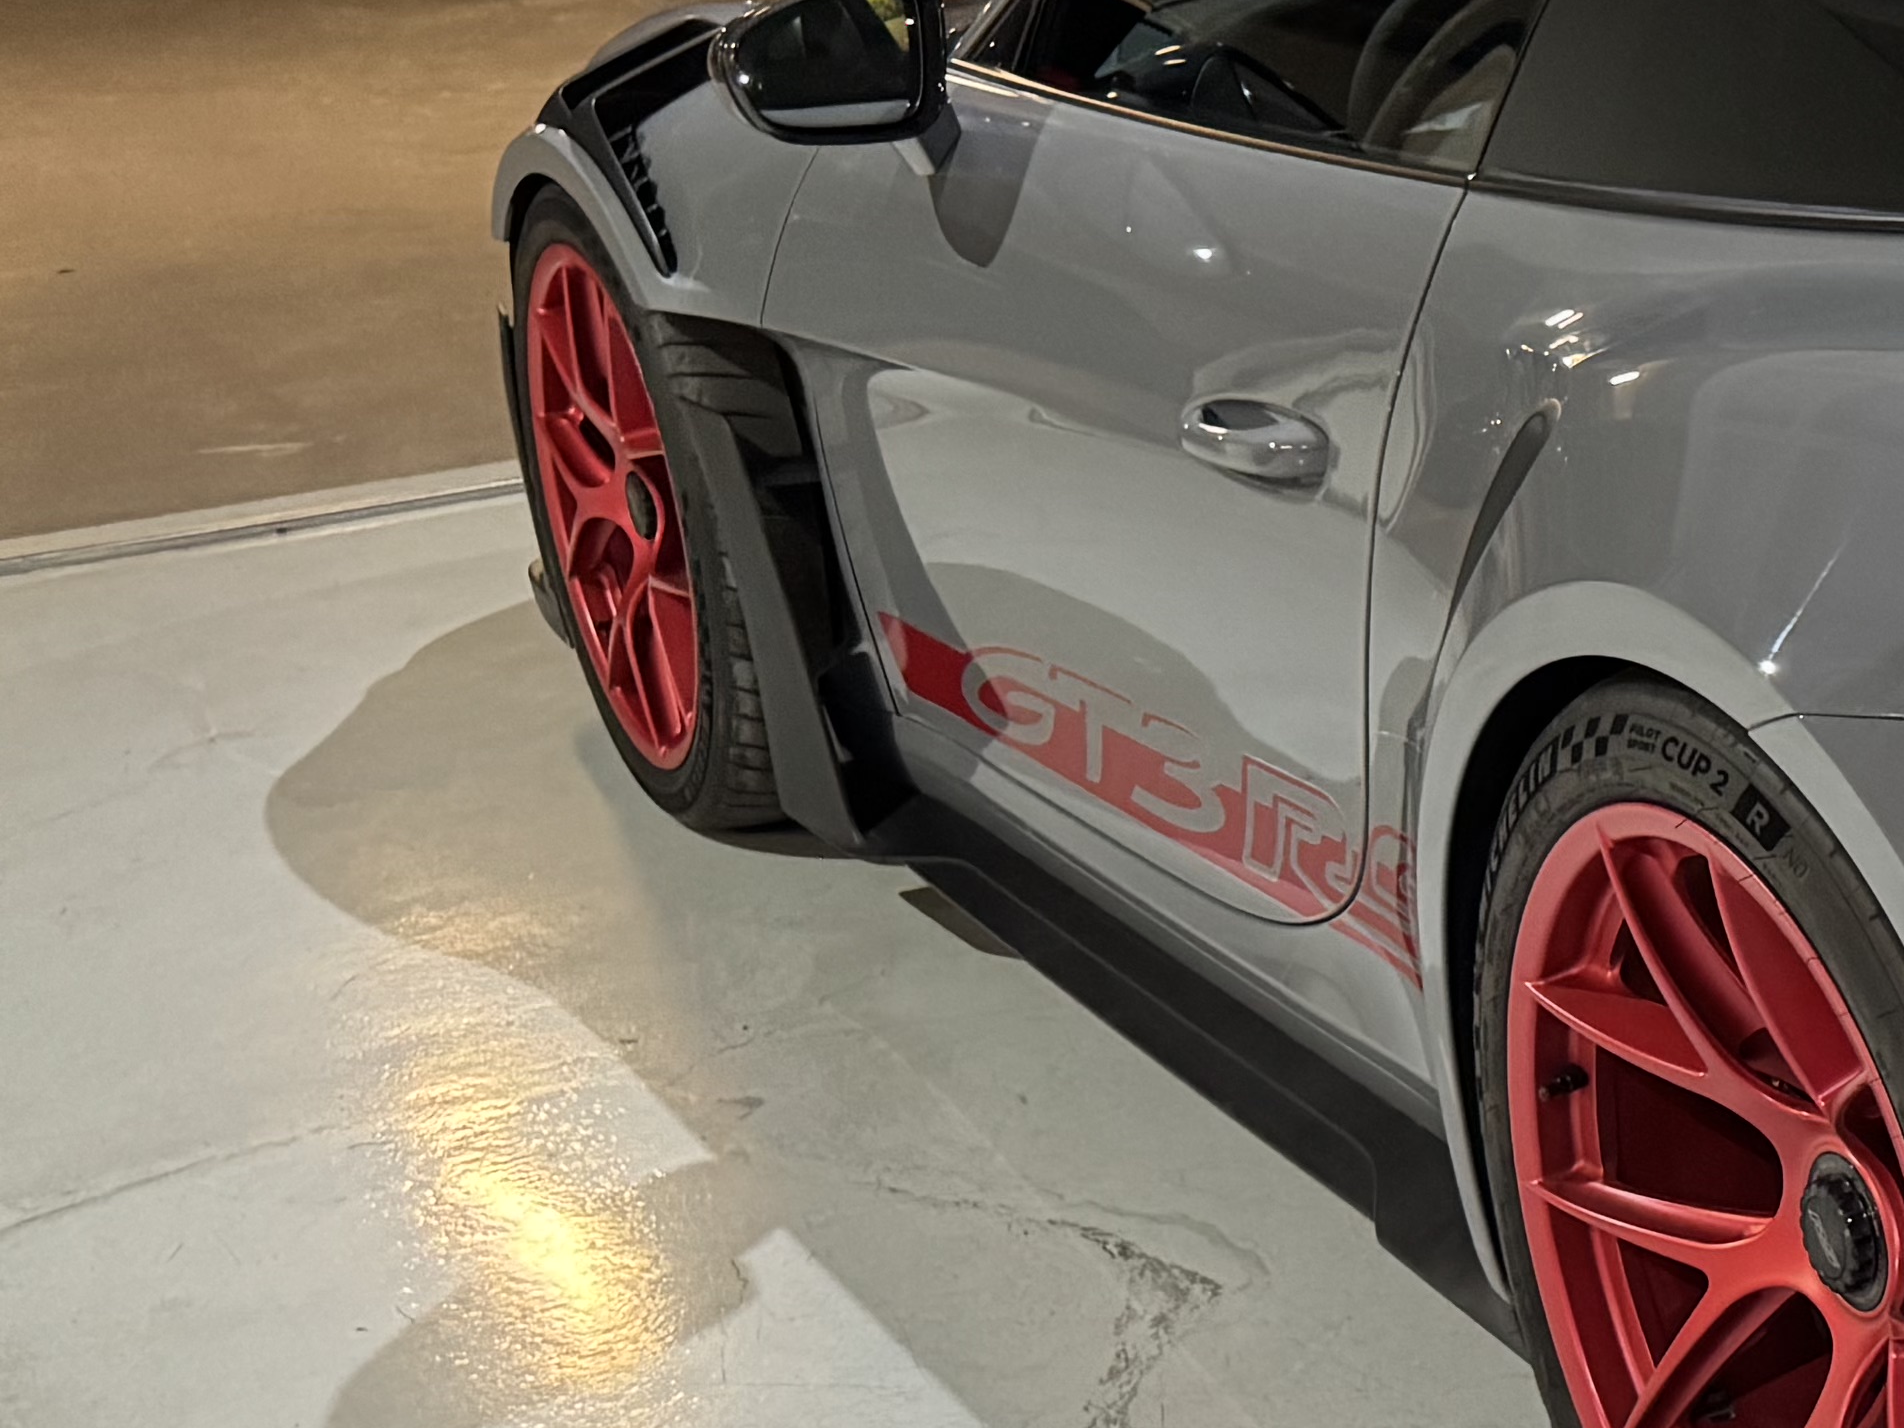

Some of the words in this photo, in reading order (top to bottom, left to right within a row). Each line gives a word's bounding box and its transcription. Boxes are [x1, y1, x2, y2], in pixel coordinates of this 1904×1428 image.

[1629, 724, 1662, 740] PILOT
[1661, 736, 1712, 776] CUP
[1709, 770, 1730, 797] 2
[1745, 802, 1771, 836] R
